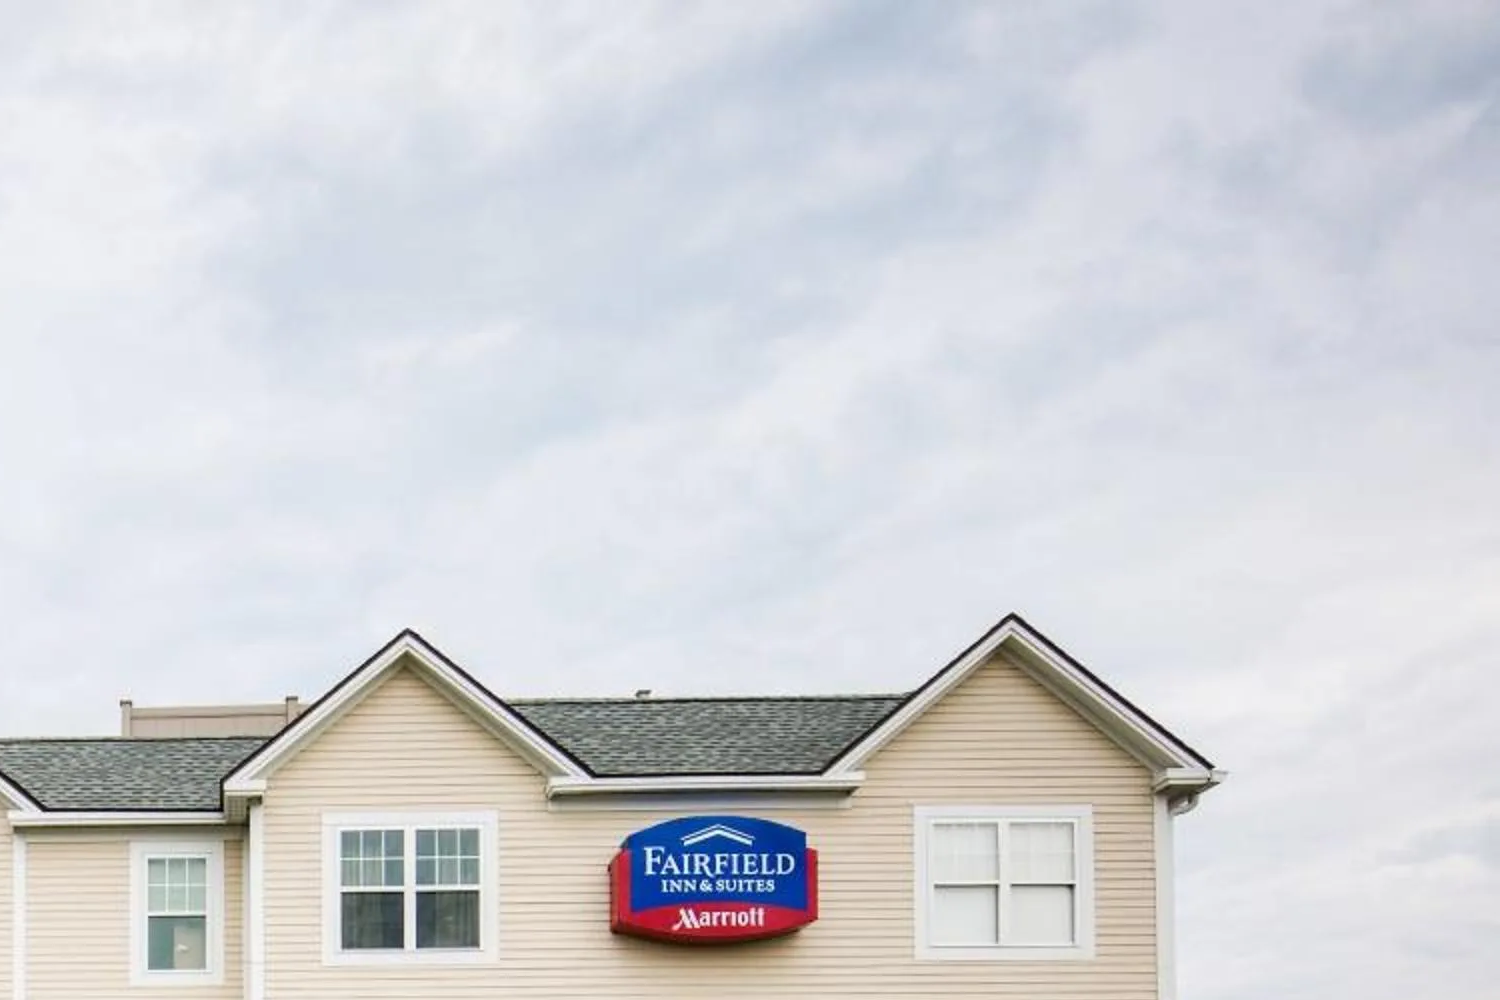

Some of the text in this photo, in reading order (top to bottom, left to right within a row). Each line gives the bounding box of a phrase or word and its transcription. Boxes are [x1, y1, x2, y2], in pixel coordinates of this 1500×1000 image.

[643, 846, 795, 878] FAIRFIELD
[661, 879, 775, 893] INN & SUITES
[671, 907, 765, 931] Marriott
